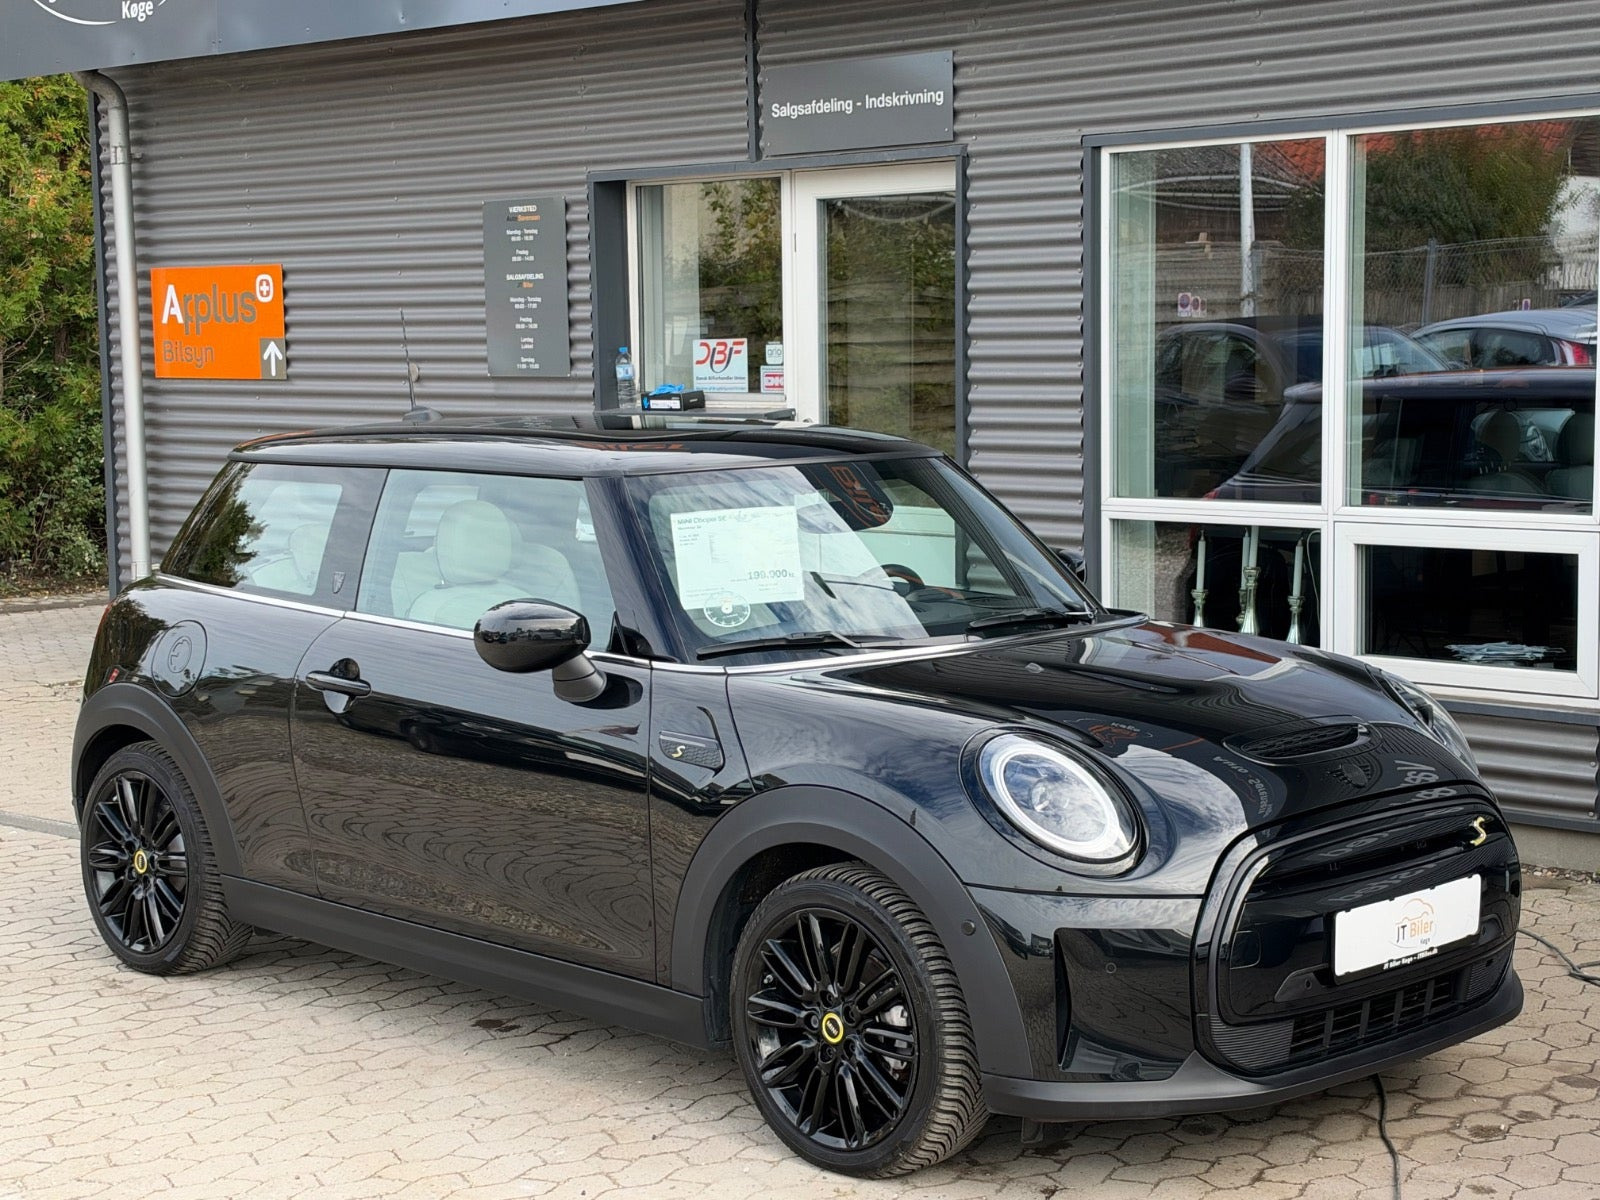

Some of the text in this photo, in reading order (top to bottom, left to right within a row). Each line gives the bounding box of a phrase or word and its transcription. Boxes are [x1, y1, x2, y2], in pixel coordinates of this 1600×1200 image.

[121, 0, 154, 22] Køge
[771, 98, 853, 119] Salgsafdeling
[865, 89, 944, 107] Indskrivning
[163, 340, 214, 369] Bilsyn
[1396, 920, 1433, 943] JT Biler
